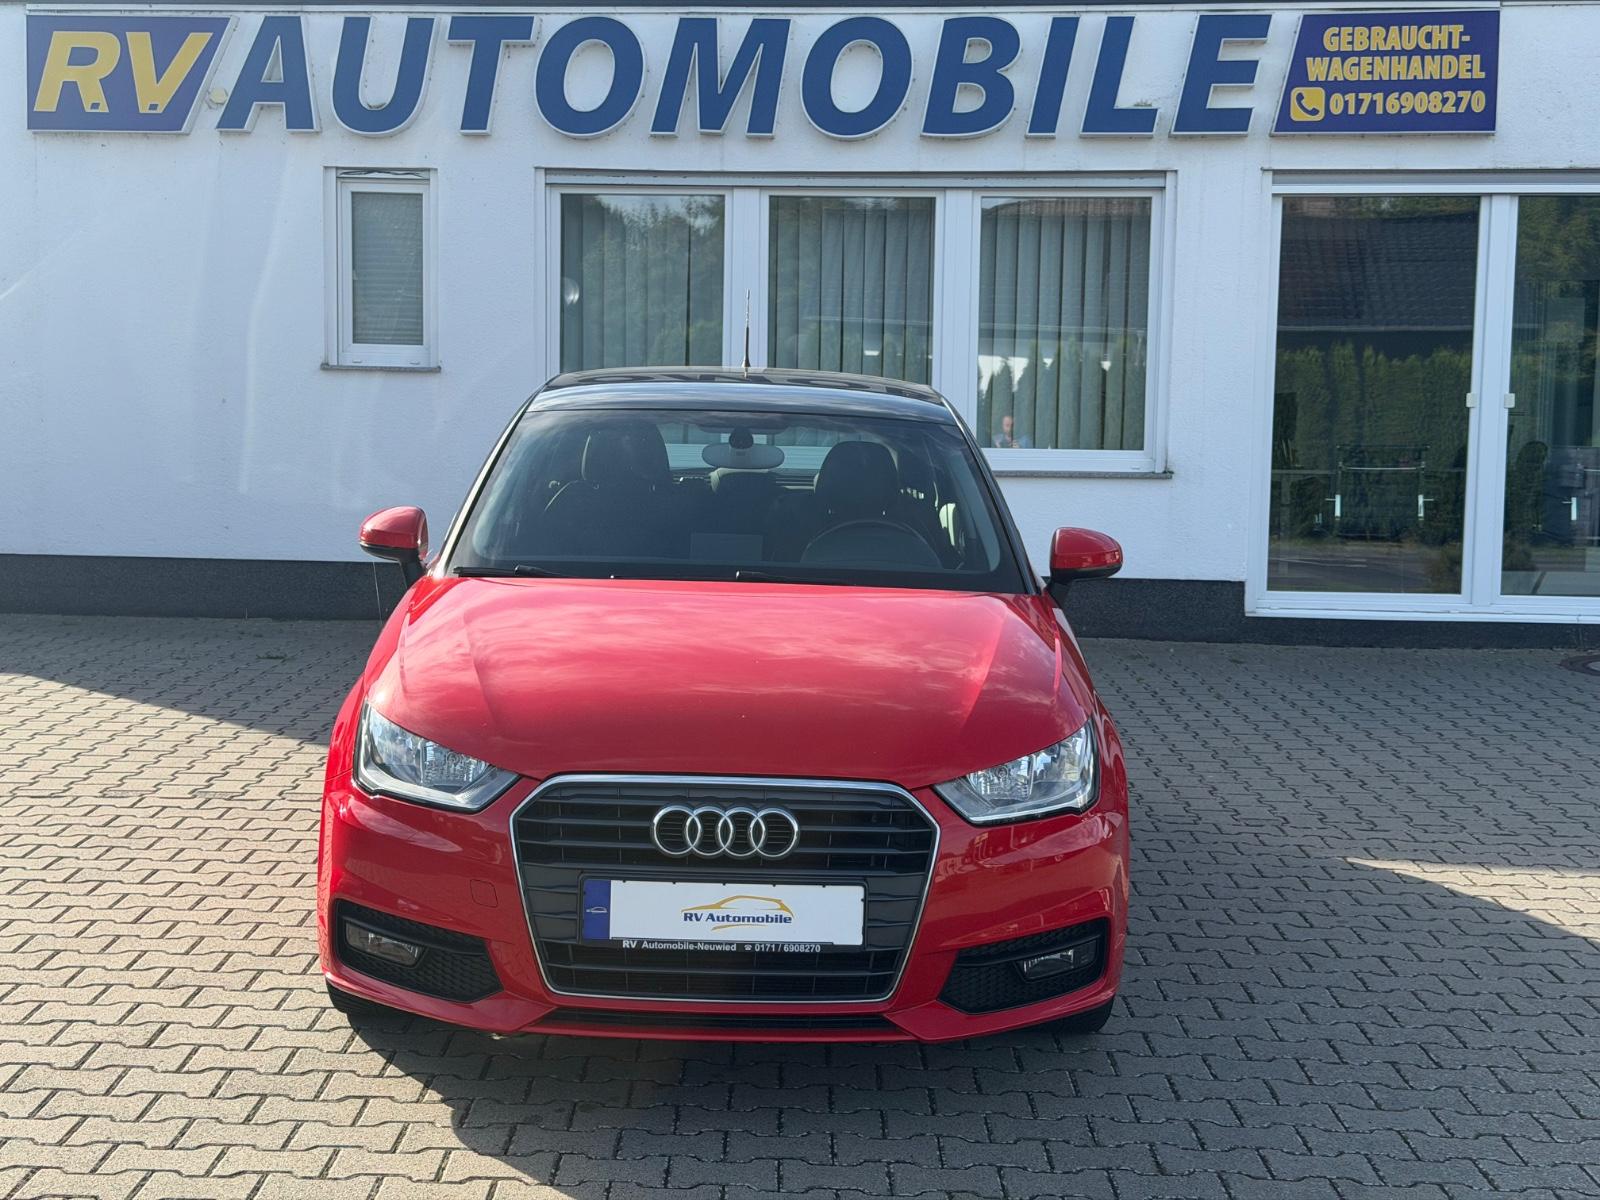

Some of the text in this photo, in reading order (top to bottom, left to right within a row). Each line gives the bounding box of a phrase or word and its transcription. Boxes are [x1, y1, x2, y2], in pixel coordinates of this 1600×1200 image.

[1323, 25, 1470, 51] GEBRAUCHT-
[216, 13, 1272, 138] AUTOMOBILE
[1306, 54, 1485, 82] WAGENHANDEL
[1329, 90, 1485, 115] 01716908270
[683, 912, 792, 924] RV Automobile
[622, 940, 637, 949] RV
[641, 940, 736, 951] Automobile-Neuwied
[754, 943, 775, 952] 0171
[783, 944, 821, 953] 6908270
